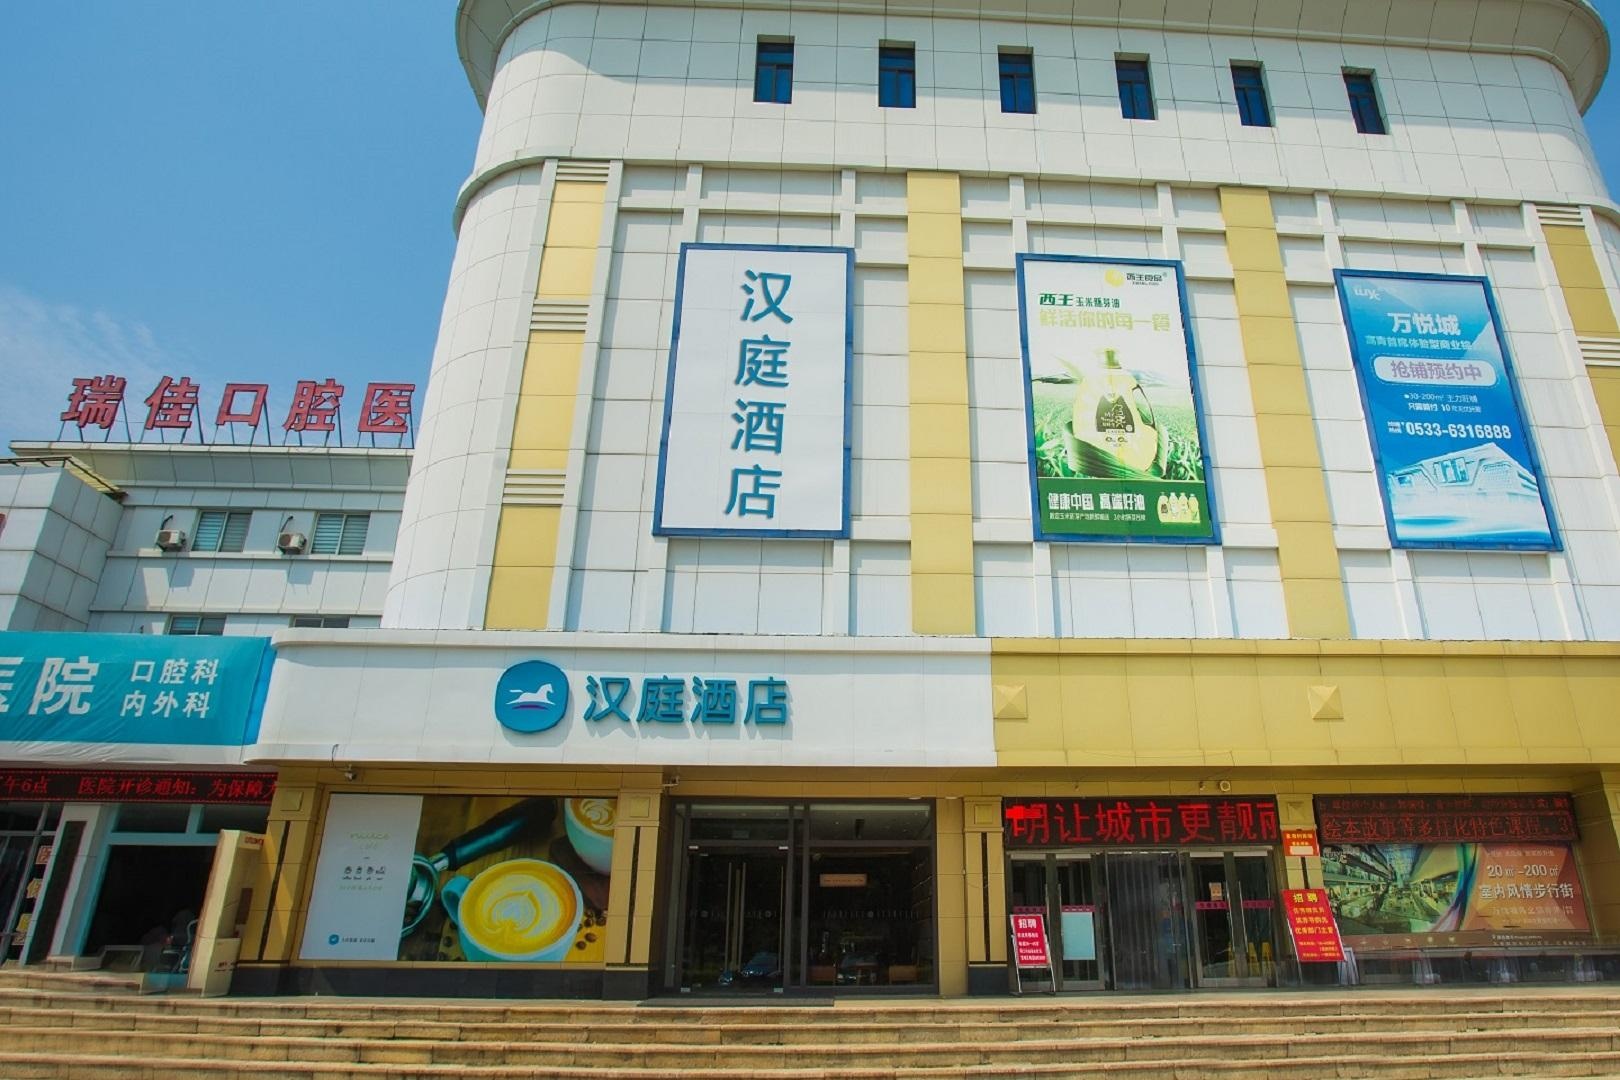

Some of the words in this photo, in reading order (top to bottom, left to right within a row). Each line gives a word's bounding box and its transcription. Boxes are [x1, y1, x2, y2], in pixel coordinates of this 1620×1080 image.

[1039, 293, 1074, 307] 西王
[1039, 310, 1170, 332] 鲜活你的每一餐
[1387, 312, 1461, 336] 万悦城
[1390, 360, 1482, 381] 抢铺预约中
[61, 374, 416, 434] 瑞佳口腔医
[723, 269, 794, 519] 汉庭酒店
[1405, 421, 1512, 440] 0533-6316888
[1048, 492, 1095, 511] 健康中国
[1099, 492, 1146, 511] 高端好油
[130, 658, 219, 685] 口腔科
[120, 690, 210, 718] 内外科
[583, 675, 788, 725] 汉庭酒店
[0, 775, 49, 795] 午6点
[1478, 883, 1575, 900] 室内风情步行街
